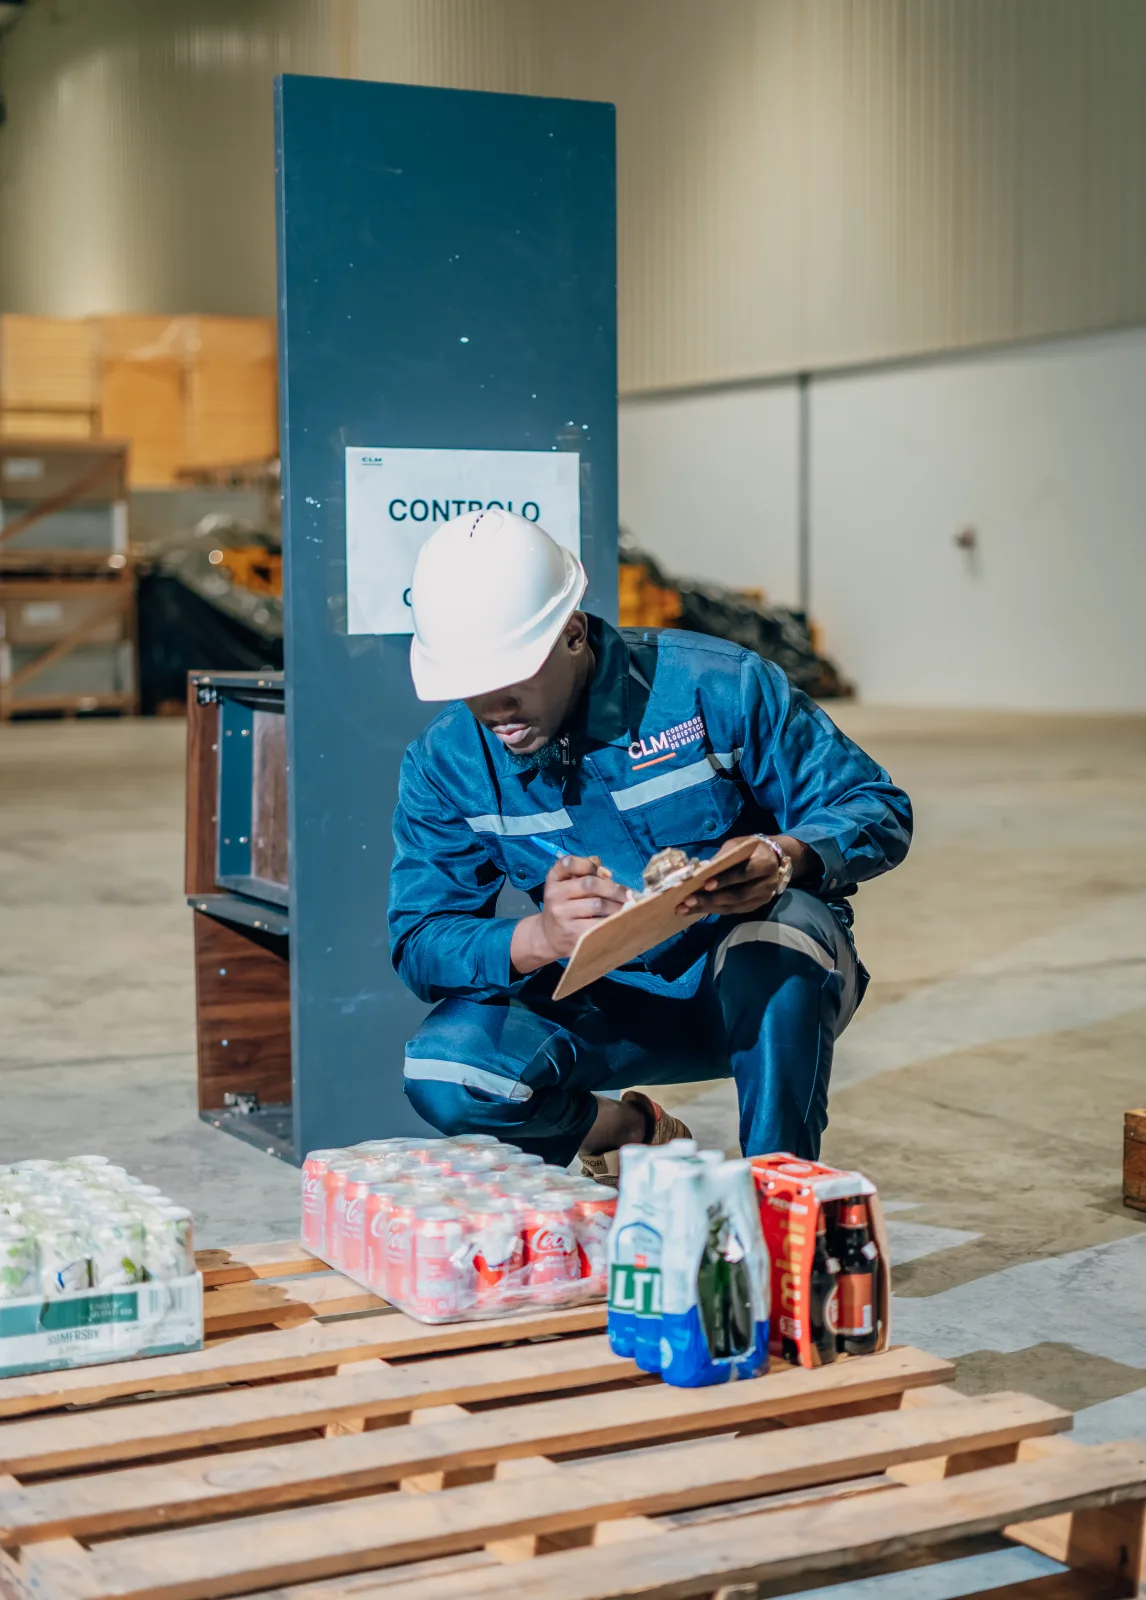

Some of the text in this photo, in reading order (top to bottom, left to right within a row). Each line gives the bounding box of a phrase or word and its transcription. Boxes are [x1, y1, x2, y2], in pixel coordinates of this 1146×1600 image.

[665, 716, 702, 736] CORREDOR
[628, 731, 669, 759] CLM
[47, 1329, 100, 1345] SOMERSBY
